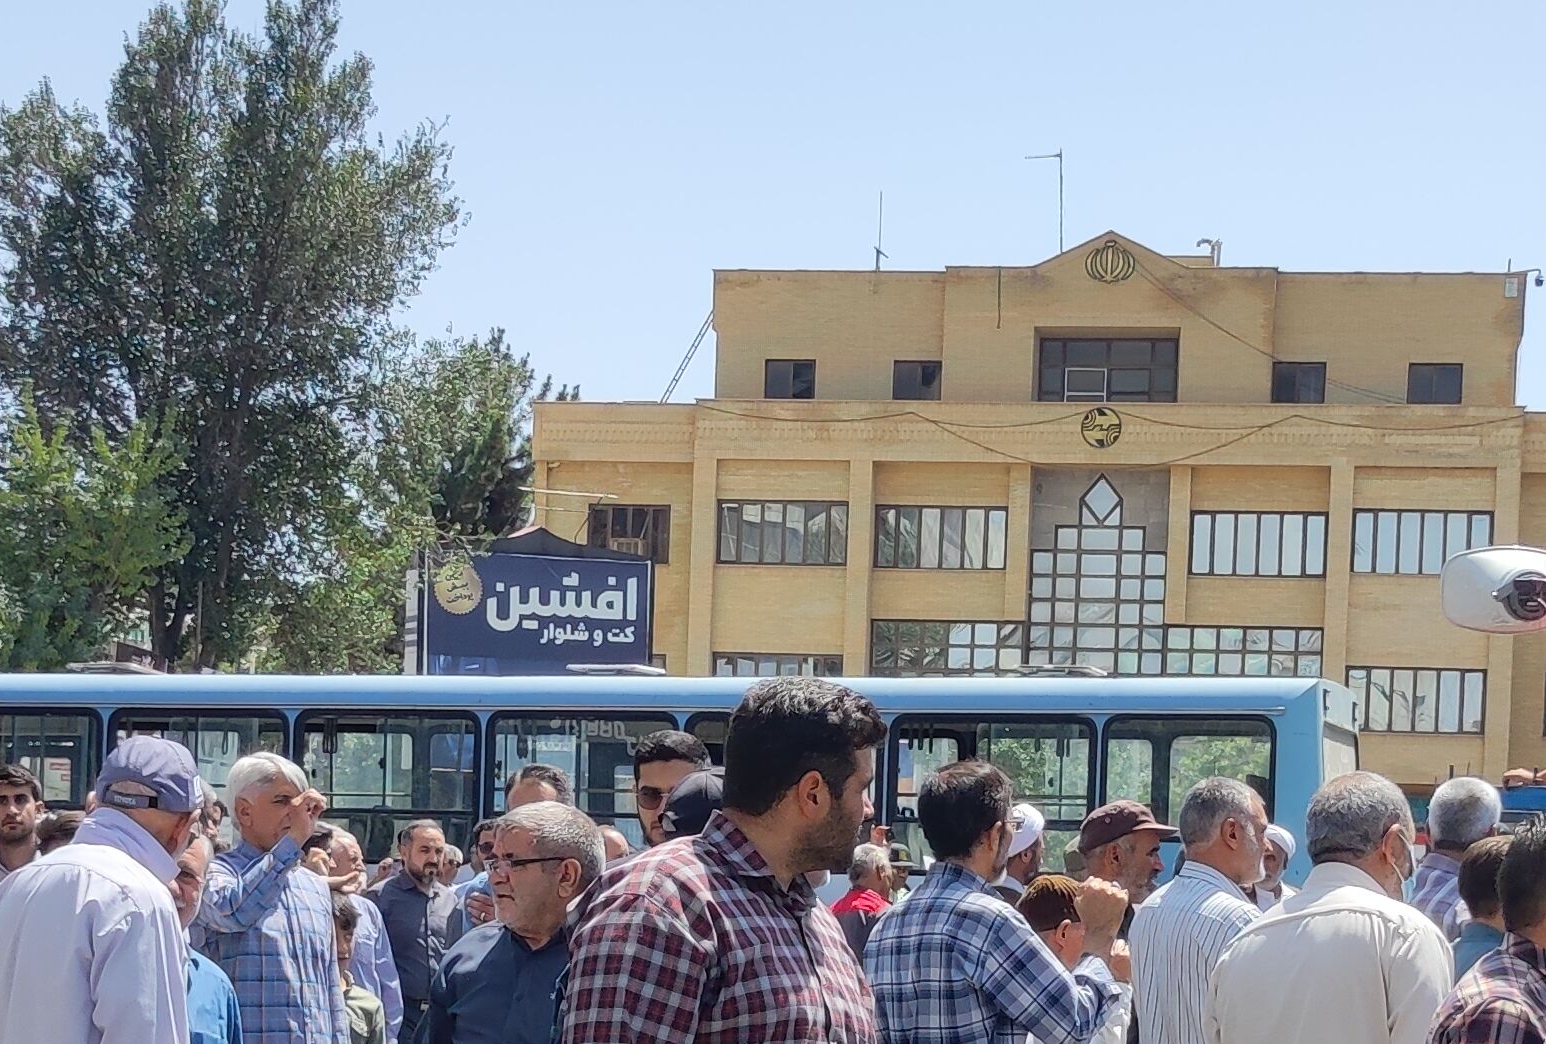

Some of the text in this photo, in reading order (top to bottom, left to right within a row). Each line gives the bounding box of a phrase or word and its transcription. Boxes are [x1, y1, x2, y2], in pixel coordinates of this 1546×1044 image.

[486, 571, 638, 632] افشین
[539, 622, 635, 647] کت و شلوار
